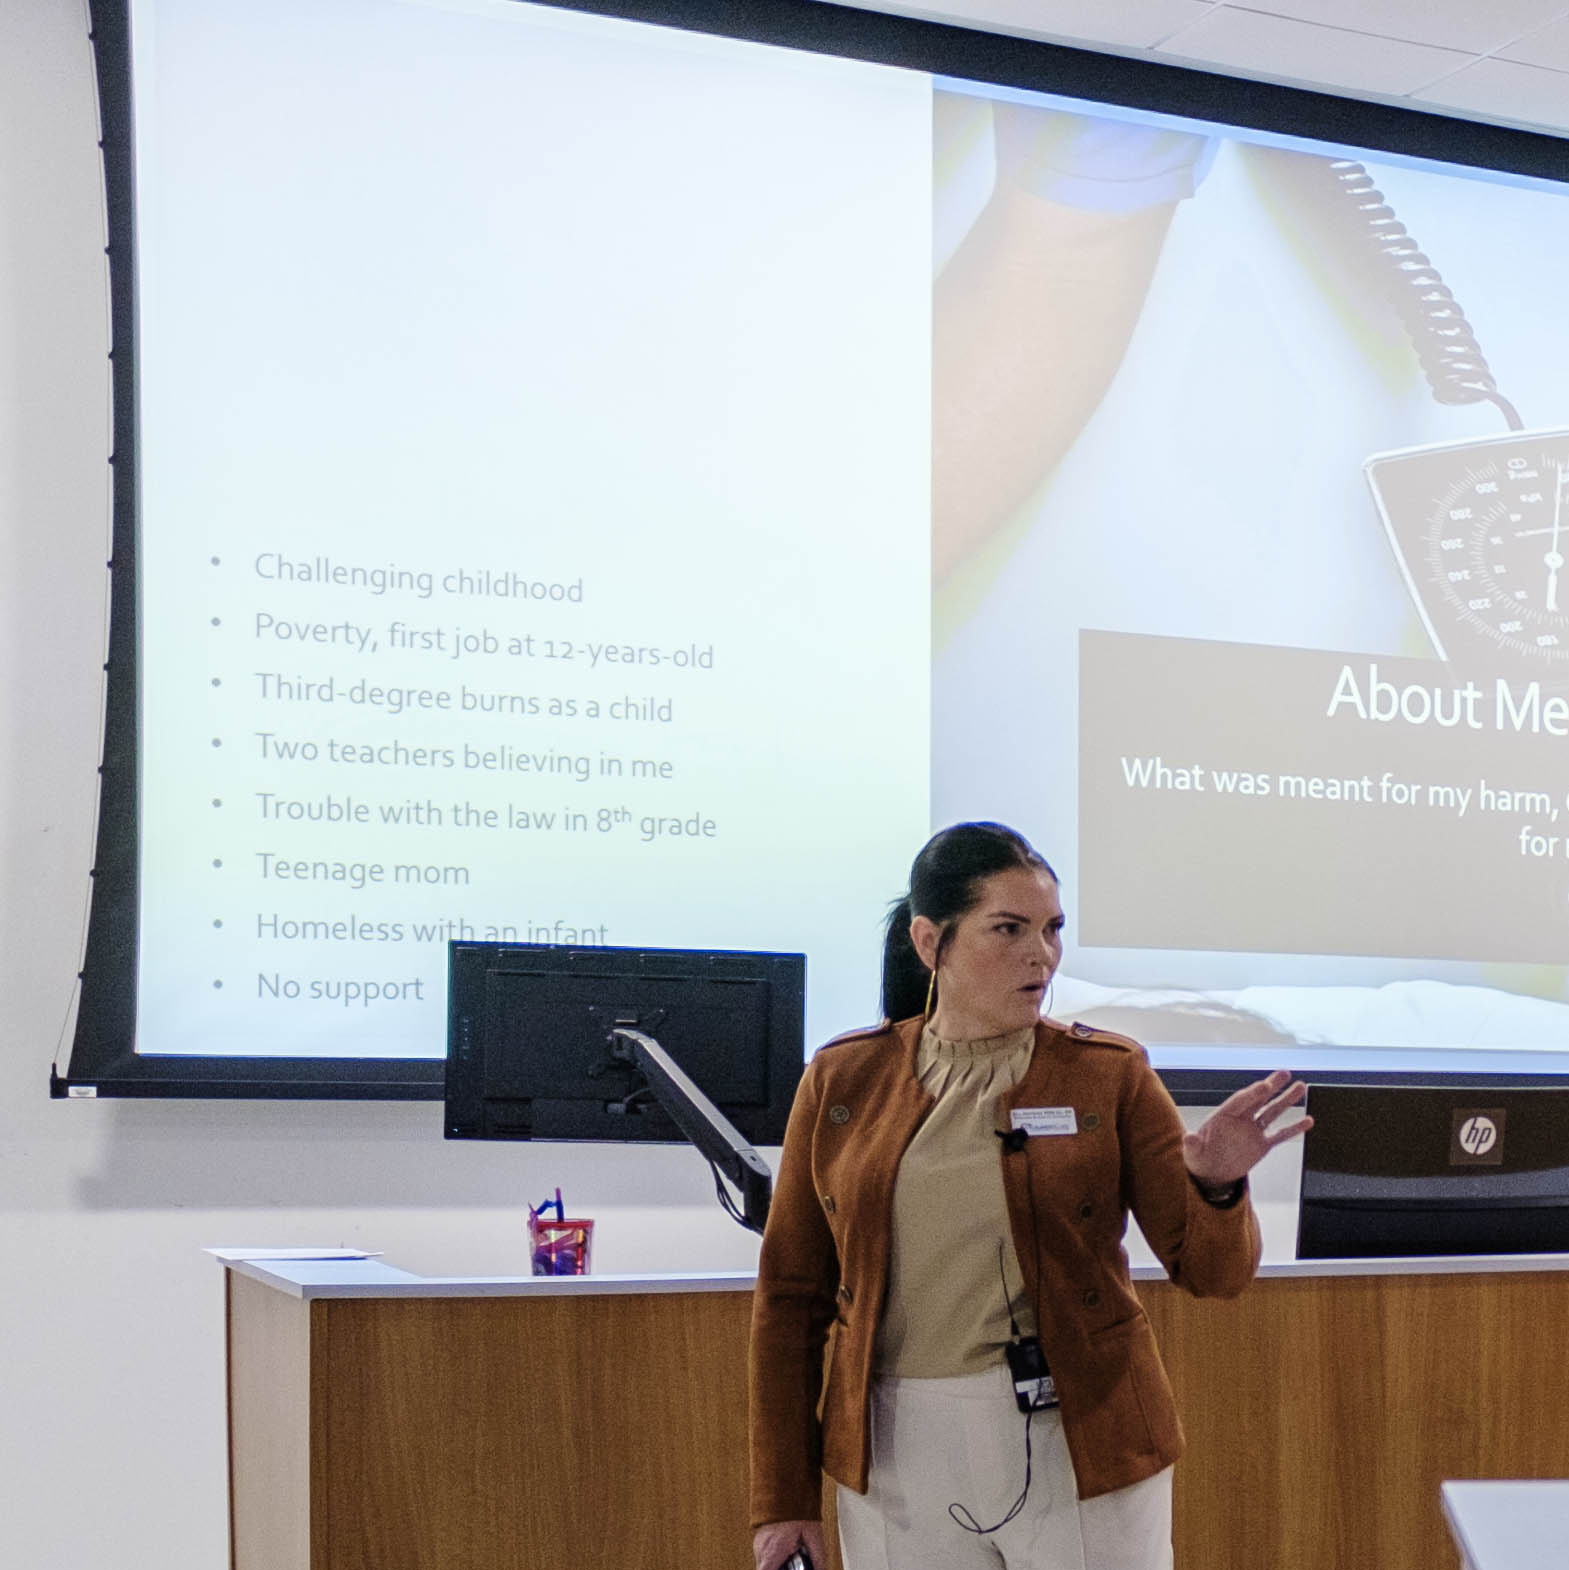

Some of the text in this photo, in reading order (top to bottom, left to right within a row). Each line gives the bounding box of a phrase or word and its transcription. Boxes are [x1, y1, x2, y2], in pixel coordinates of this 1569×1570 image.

[254, 552, 583, 603] Challenging childhood
[255, 612, 713, 669] Poverty, first job at 12-years-old
[255, 672, 673, 723] Third-degree burns as a child
[1326, 663, 1569, 736] About Me
[255, 732, 673, 783] Two teachers believing in me
[1121, 756, 1205, 792] What
[1211, 770, 1271, 796] was
[1278, 775, 1374, 802] meant
[1379, 772, 1422, 806] for
[1428, 785, 1473, 817] my
[1479, 779, 1559, 823] harm,
[255, 792, 717, 842] Trouble with the law in 8th grade
[1518, 825, 1560, 857] for
[255, 852, 470, 890] Teenage mom
[257, 913, 609, 945] Homeless with an infant
[257, 972, 425, 1008] No support
[1463, 1117, 1493, 1154] hp
